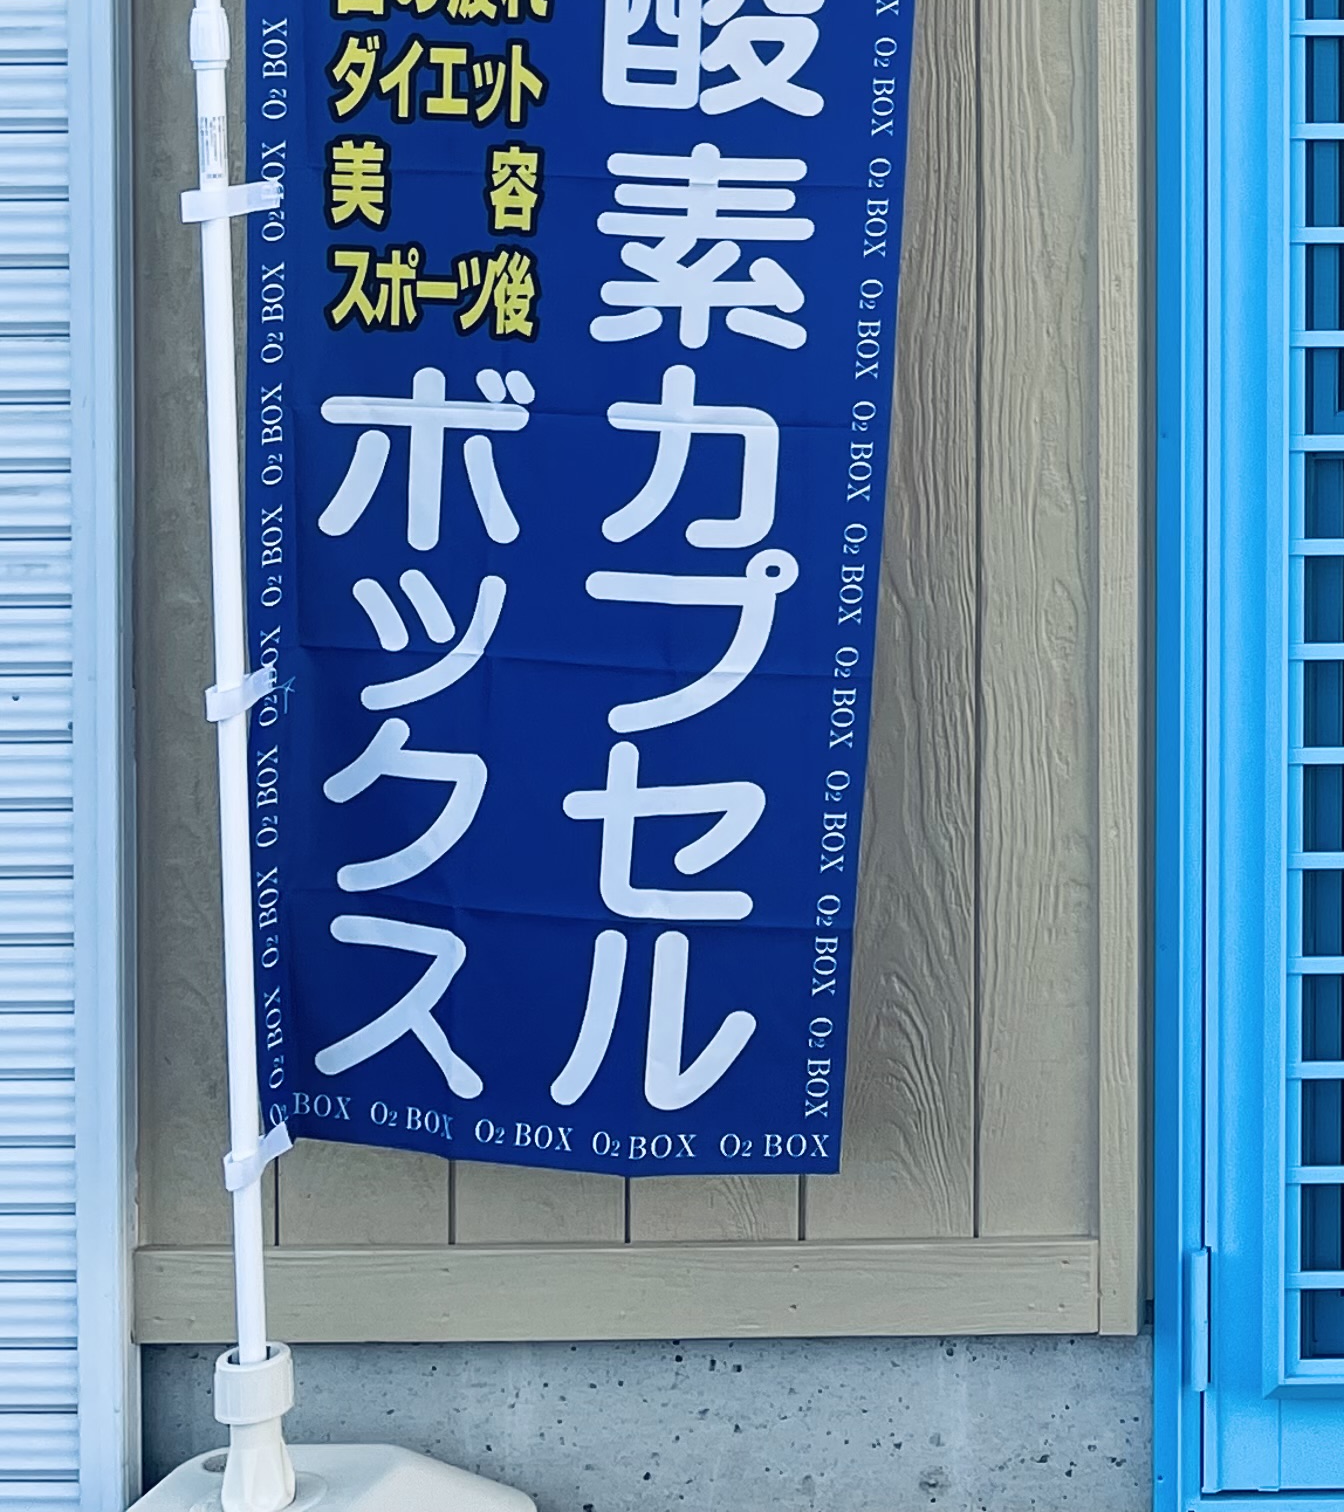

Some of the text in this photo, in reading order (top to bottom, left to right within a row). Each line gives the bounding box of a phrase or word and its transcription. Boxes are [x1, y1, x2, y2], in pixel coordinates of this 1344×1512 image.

[262, 18, 288, 79] BOX
[332, 35, 543, 123] ダイエット
[870, 78, 895, 136] BOX
[863, 198, 890, 258] BOX
[261, 262, 285, 324] BOX
[331, 247, 536, 337] スポーツ後
[855, 320, 881, 379] BOX
[261, 382, 283, 446] BOX
[846, 442, 874, 501] BOX
[261, 504, 283, 567] BOX
[838, 564, 865, 625] BOX
[259, 626, 281, 683] OX
[314, 366, 535, 1100] ボックス
[829, 688, 857, 749] BOX
[256, 745, 278, 808] BOX
[820, 812, 848, 872] BOX
[256, 866, 279, 930] BOX
[811, 936, 839, 996] BOX
[263, 986, 283, 1051] BOX
[804, 1058, 831, 1117] BOX
[292, 1092, 351, 1120] BOX
[406, 1106, 453, 1140] BOX
[514, 1122, 573, 1152] BOX
[628, 1134, 697, 1160] BOX
[763, 1133, 830, 1158] BOX
